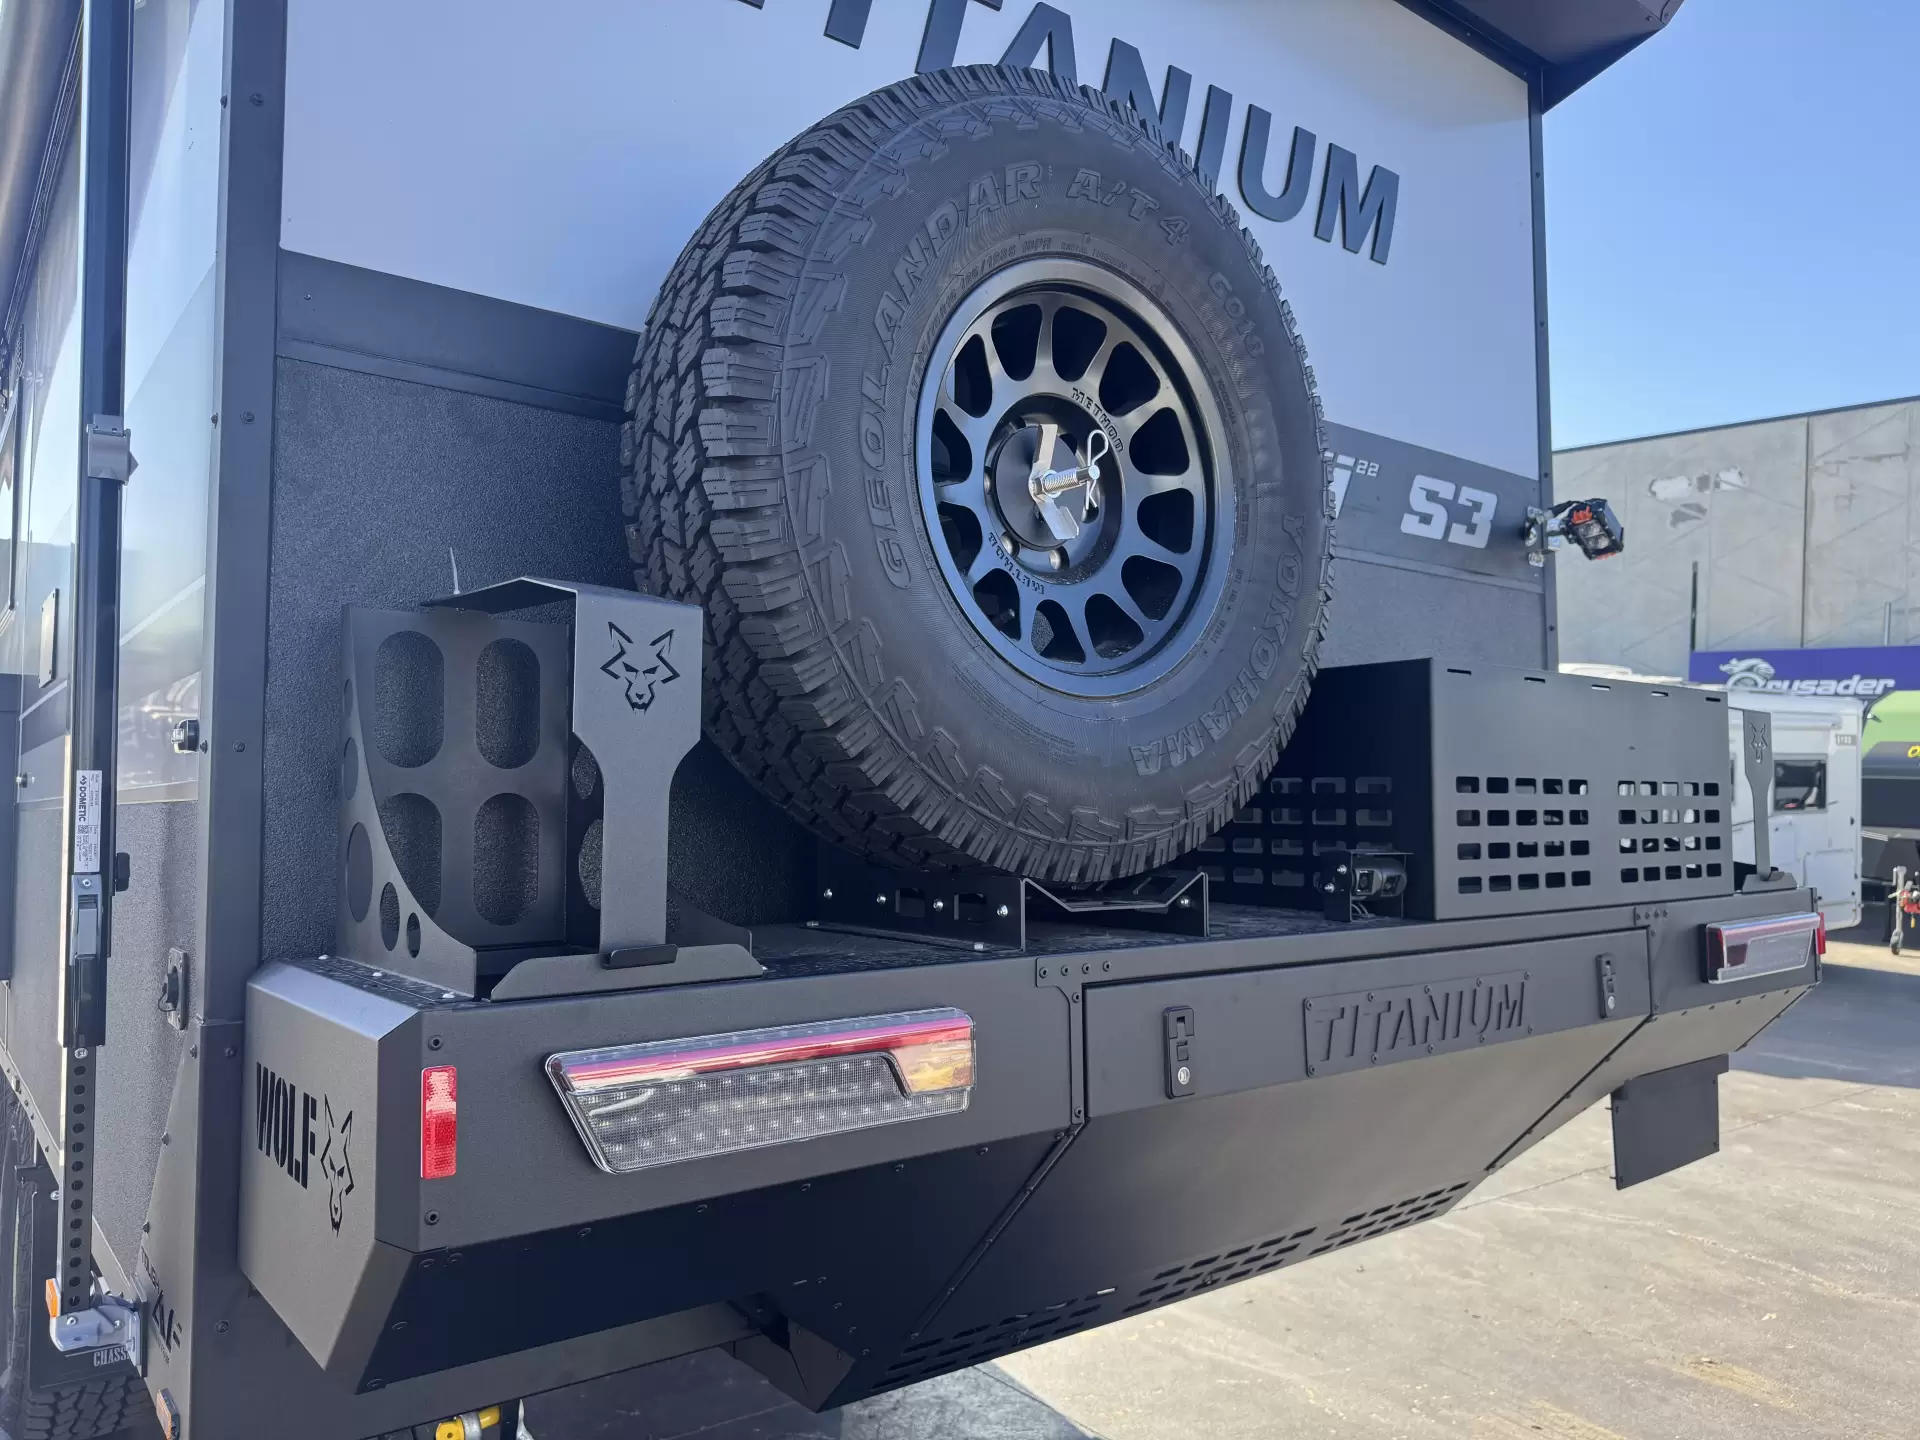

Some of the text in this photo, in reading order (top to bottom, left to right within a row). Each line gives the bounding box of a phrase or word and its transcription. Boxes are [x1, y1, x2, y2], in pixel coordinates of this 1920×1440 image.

[749, 0, 1400, 265] TANIUM
[859, 160, 1042, 589] GEOLANDAR
[1071, 387, 1125, 453] METHOD
[1401, 474, 1498, 549] S3
[987, 531, 1045, 596] METHOD
[1129, 513, 1305, 776] YOKOHAMA
[78, 786, 88, 822] DOMETIC
[1314, 981, 1525, 1062] TITANIUM
[256, 1061, 317, 1190] WOLF
